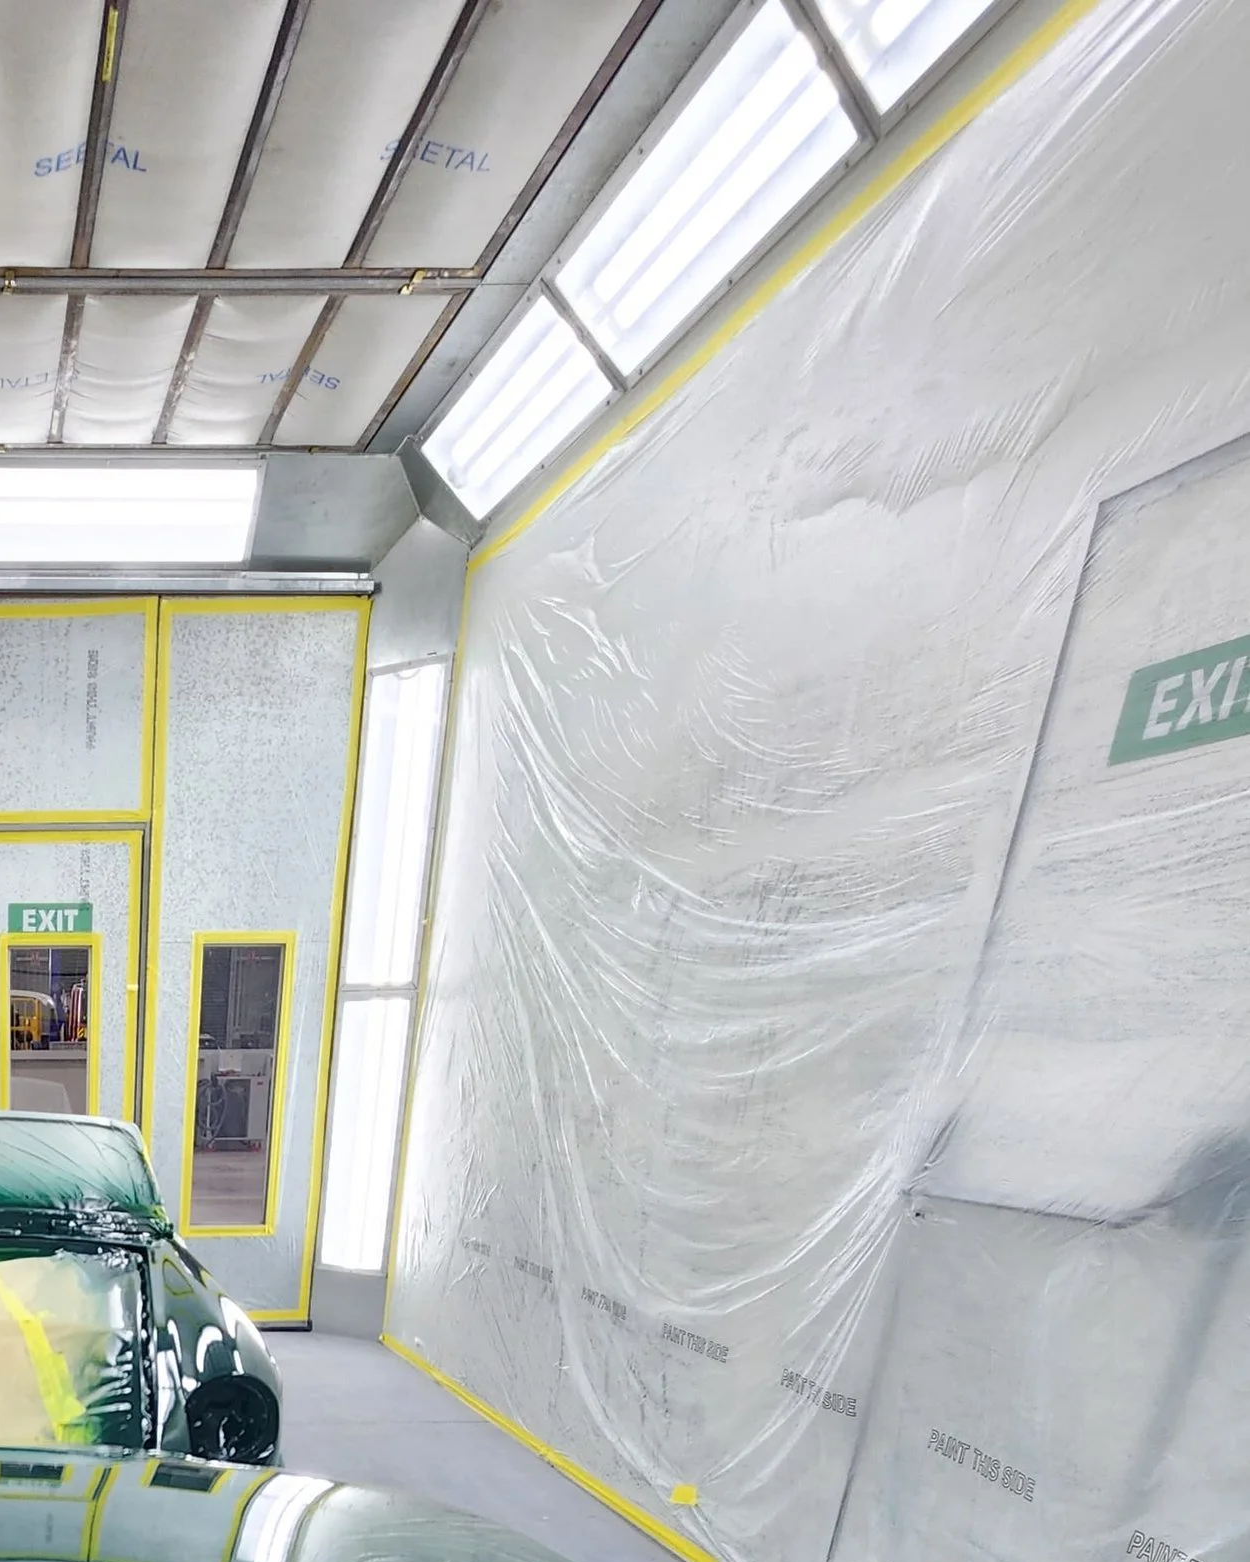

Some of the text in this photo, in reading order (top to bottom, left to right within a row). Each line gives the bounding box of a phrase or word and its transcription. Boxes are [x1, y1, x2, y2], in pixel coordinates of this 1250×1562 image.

[1142, 656, 1250, 740] EXI
[22, 909, 79, 932] EXIT
[822, 1391, 857, 1417] SIDE
[926, 1428, 1037, 1503] PAINT THIS SIDE
